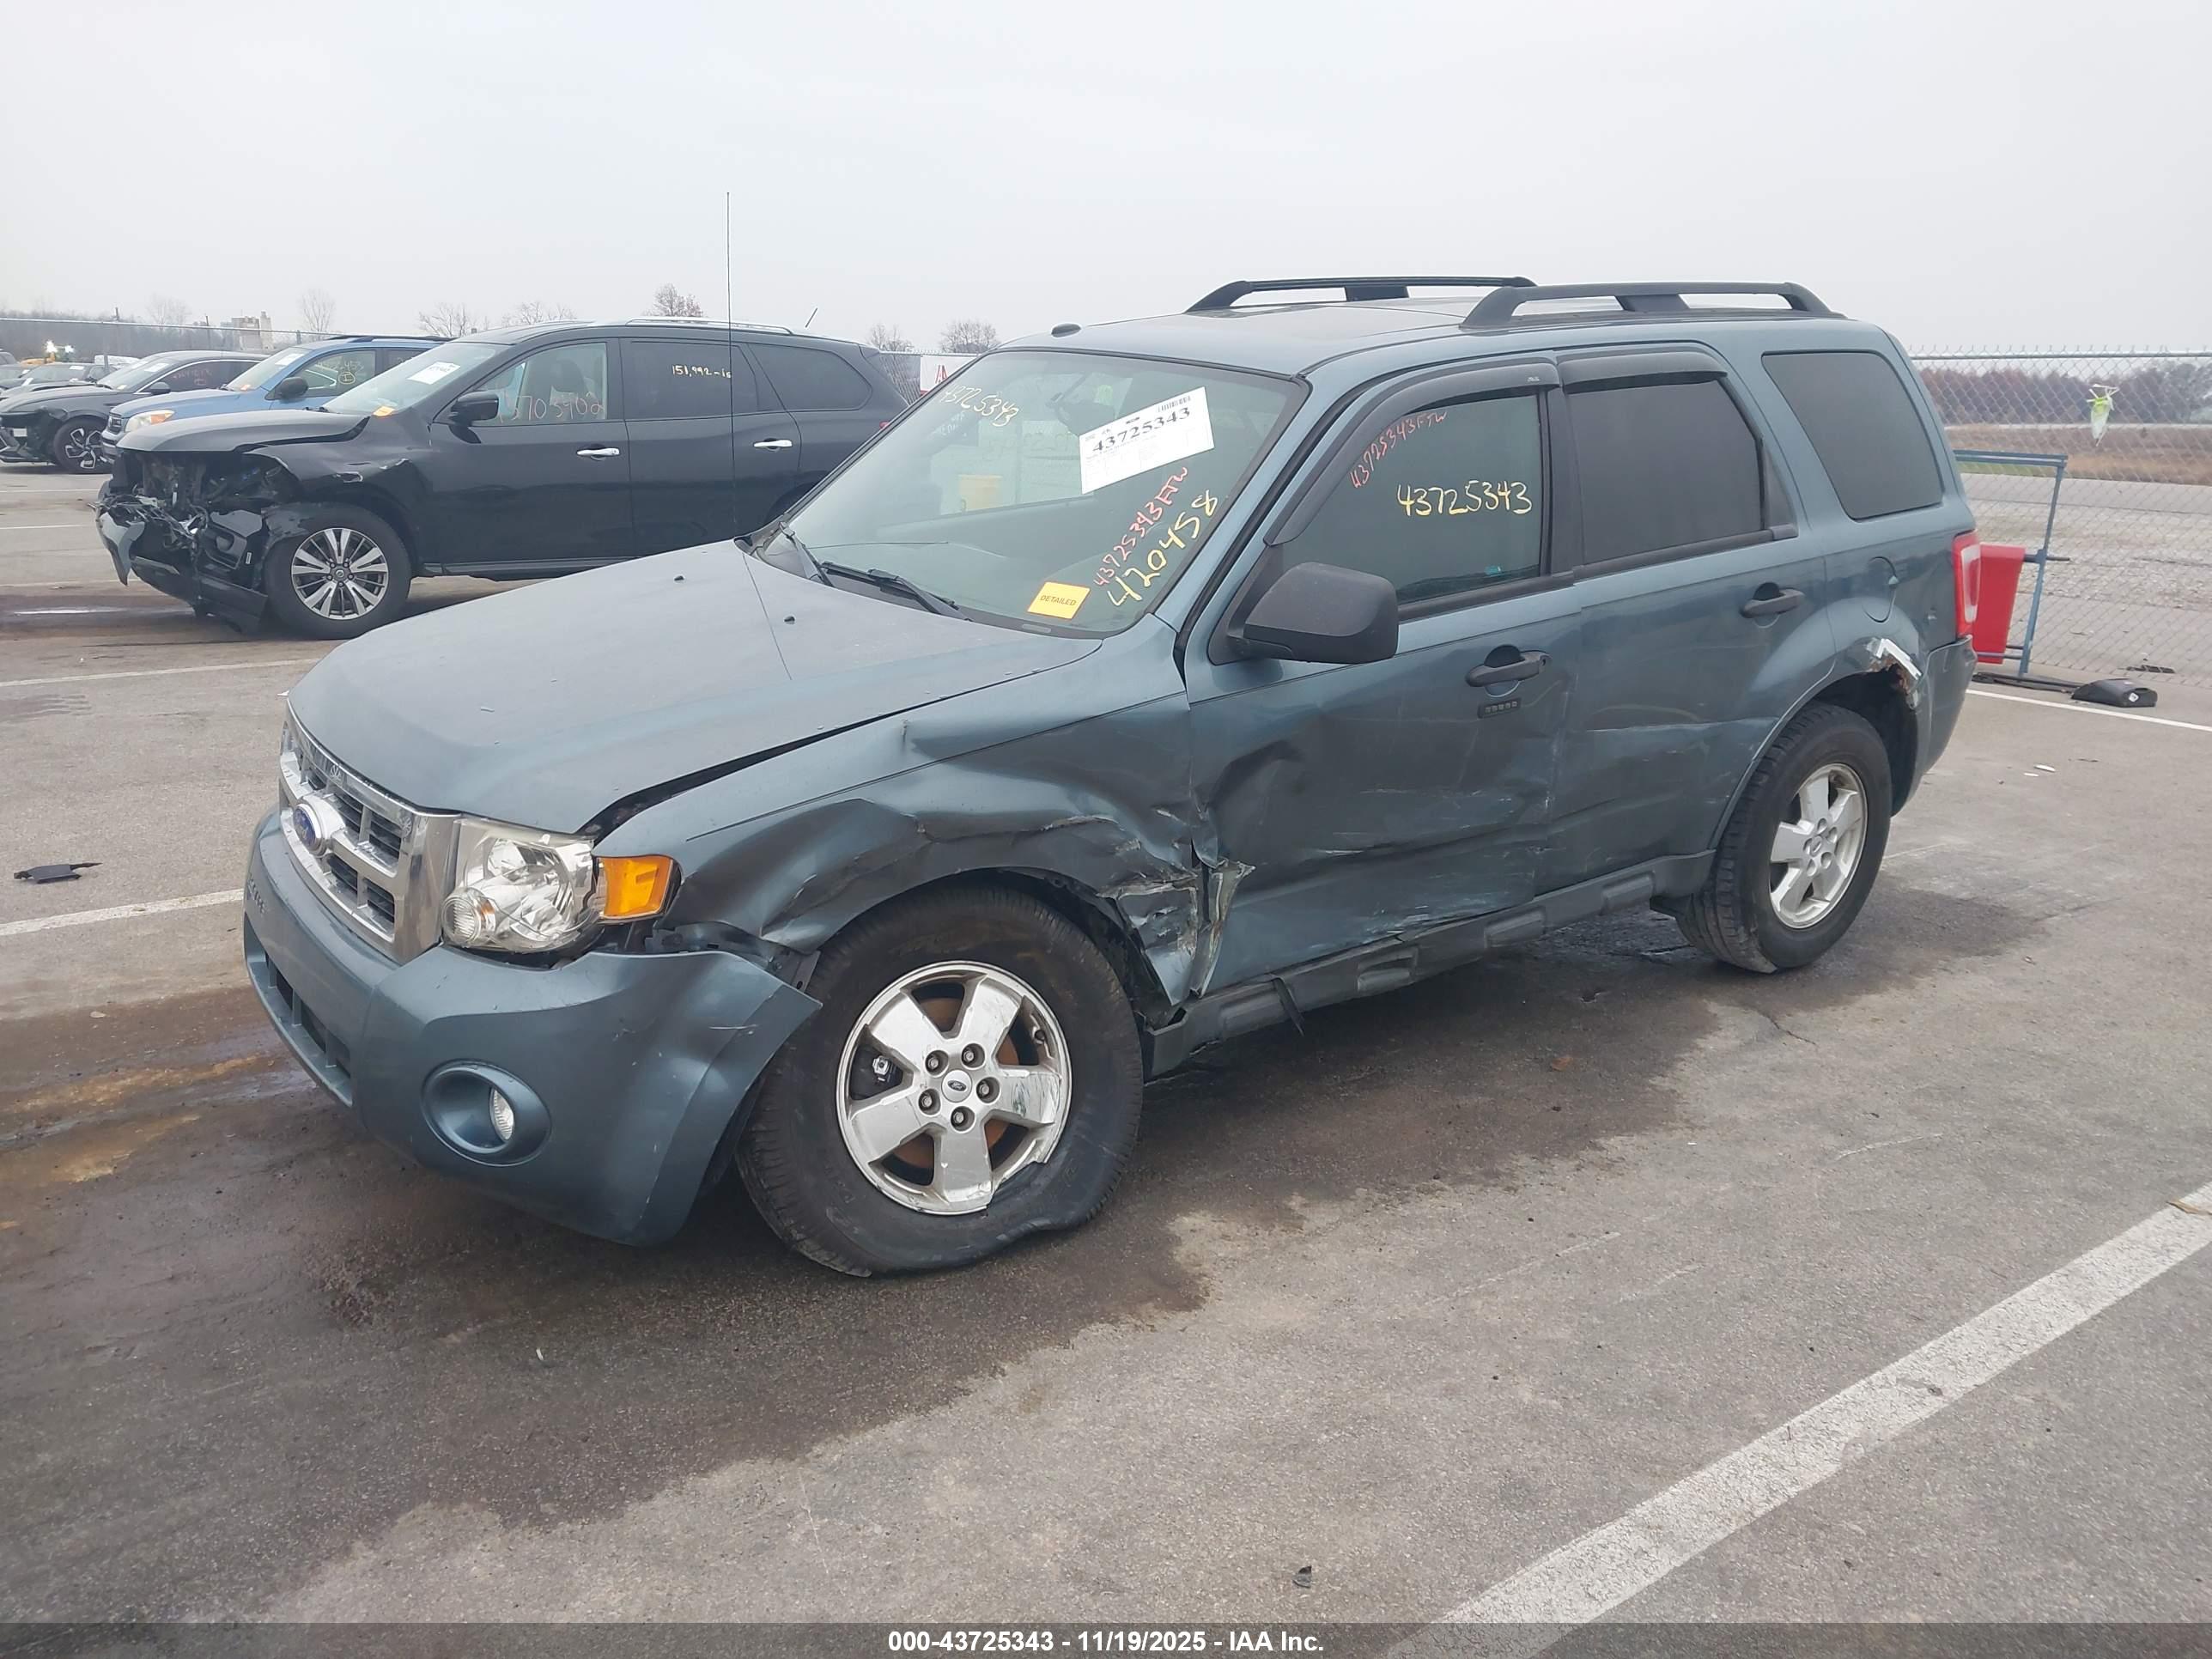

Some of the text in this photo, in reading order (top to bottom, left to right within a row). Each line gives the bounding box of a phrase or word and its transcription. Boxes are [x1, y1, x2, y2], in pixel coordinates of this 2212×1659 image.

[1092, 407, 1191, 452] 43725343
[1396, 479, 1533, 516] 43725343
[1106, 489, 1218, 606] 420458
[1040, 594, 1077, 606] DETAILED
